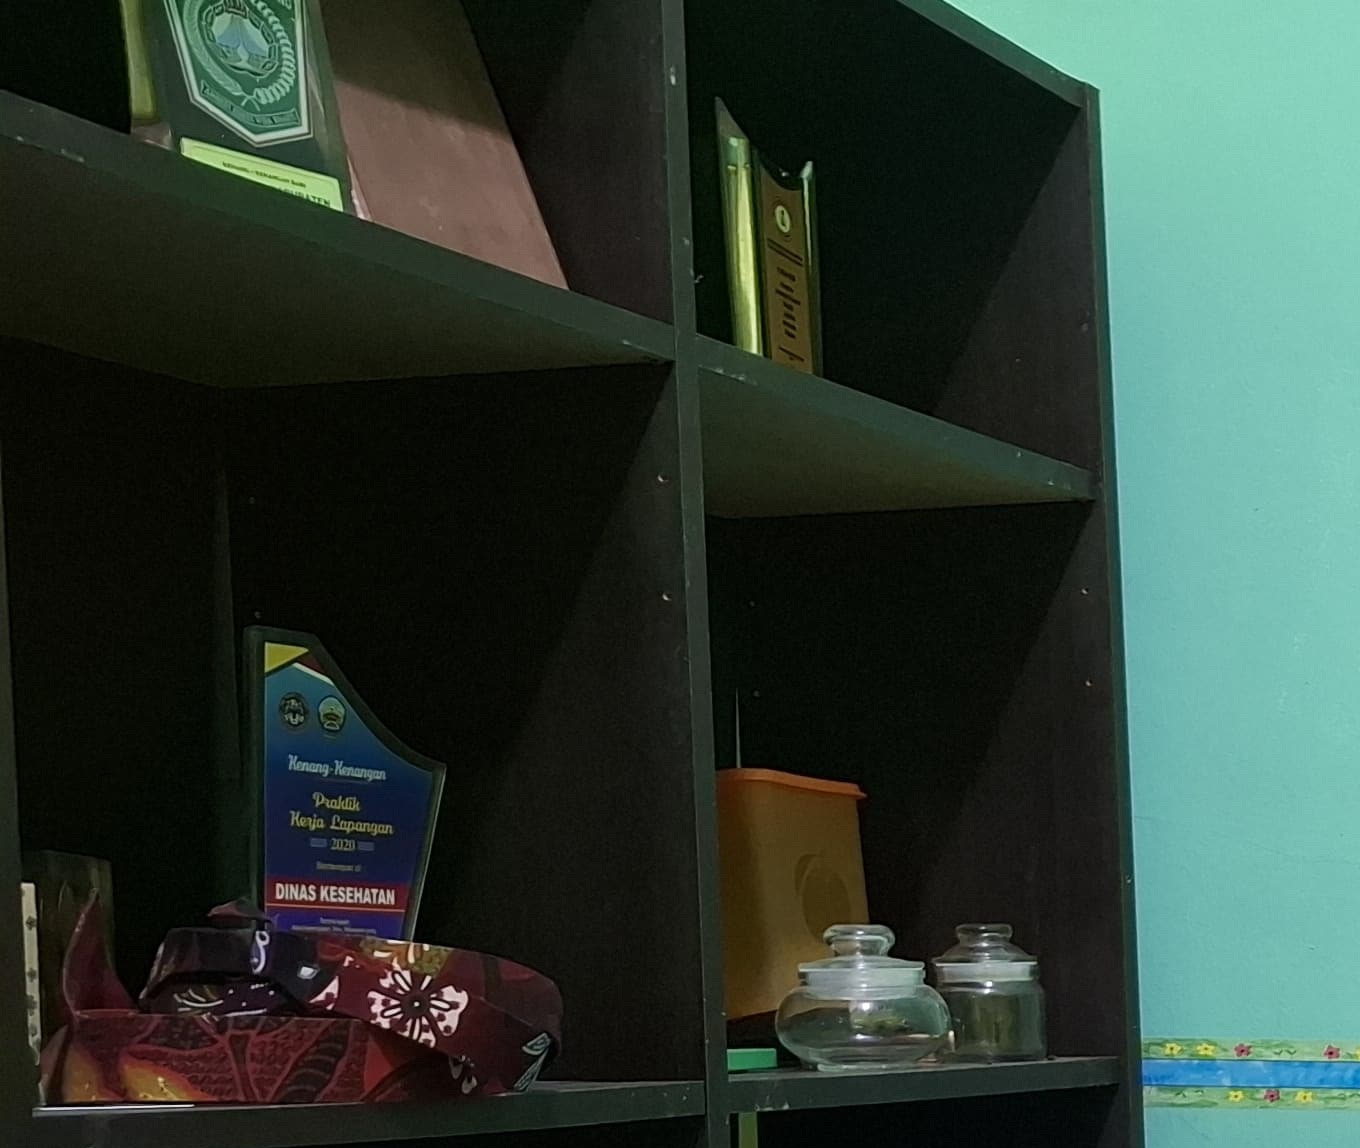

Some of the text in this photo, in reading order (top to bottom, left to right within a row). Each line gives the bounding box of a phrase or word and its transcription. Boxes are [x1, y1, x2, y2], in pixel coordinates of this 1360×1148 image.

[289, 810, 394, 836] Kerja Lapangan
[330, 838, 356, 851] 2020
[275, 882, 396, 906] DINAS KESEHATAN
